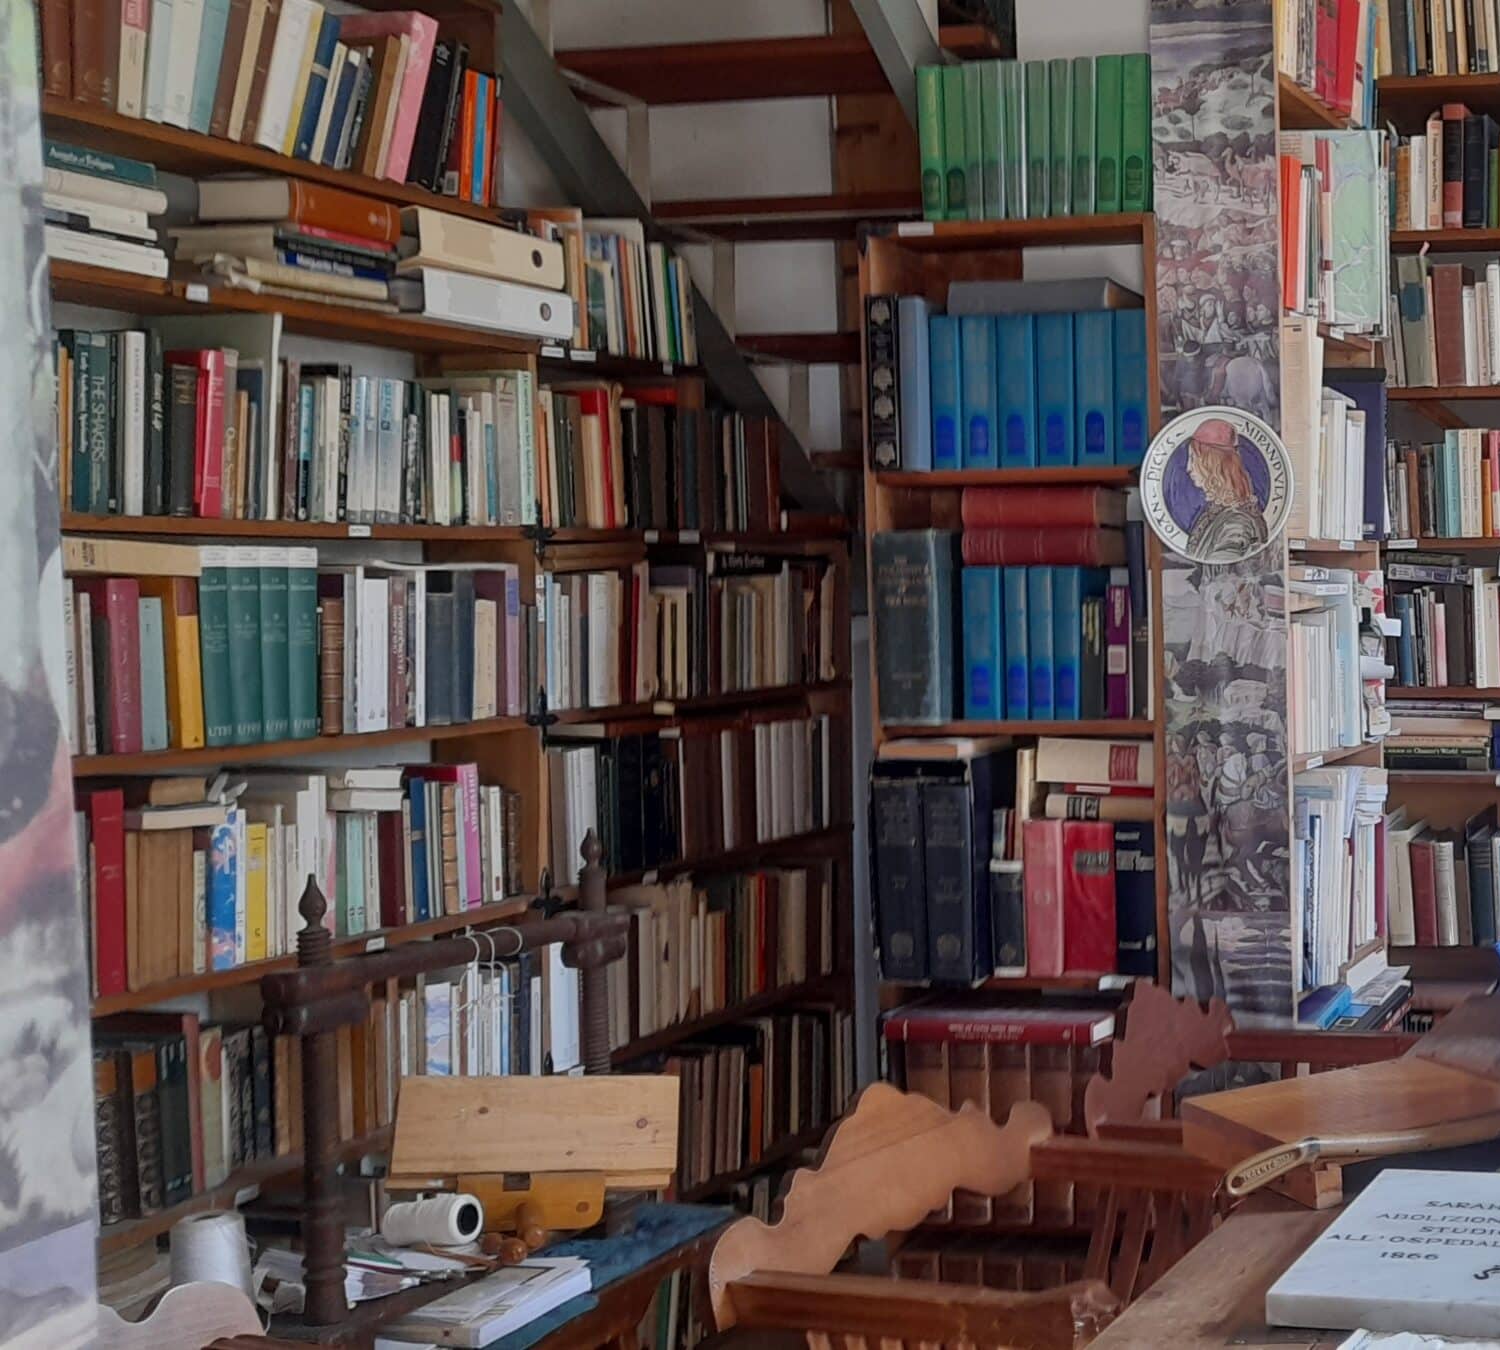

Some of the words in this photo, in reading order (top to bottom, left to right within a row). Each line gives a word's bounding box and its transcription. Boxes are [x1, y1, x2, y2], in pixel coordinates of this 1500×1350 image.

[91, 375, 105, 399] THE
[91, 402, 105, 462] SHAKERS
[1379, 1250, 1440, 1261] 1866
